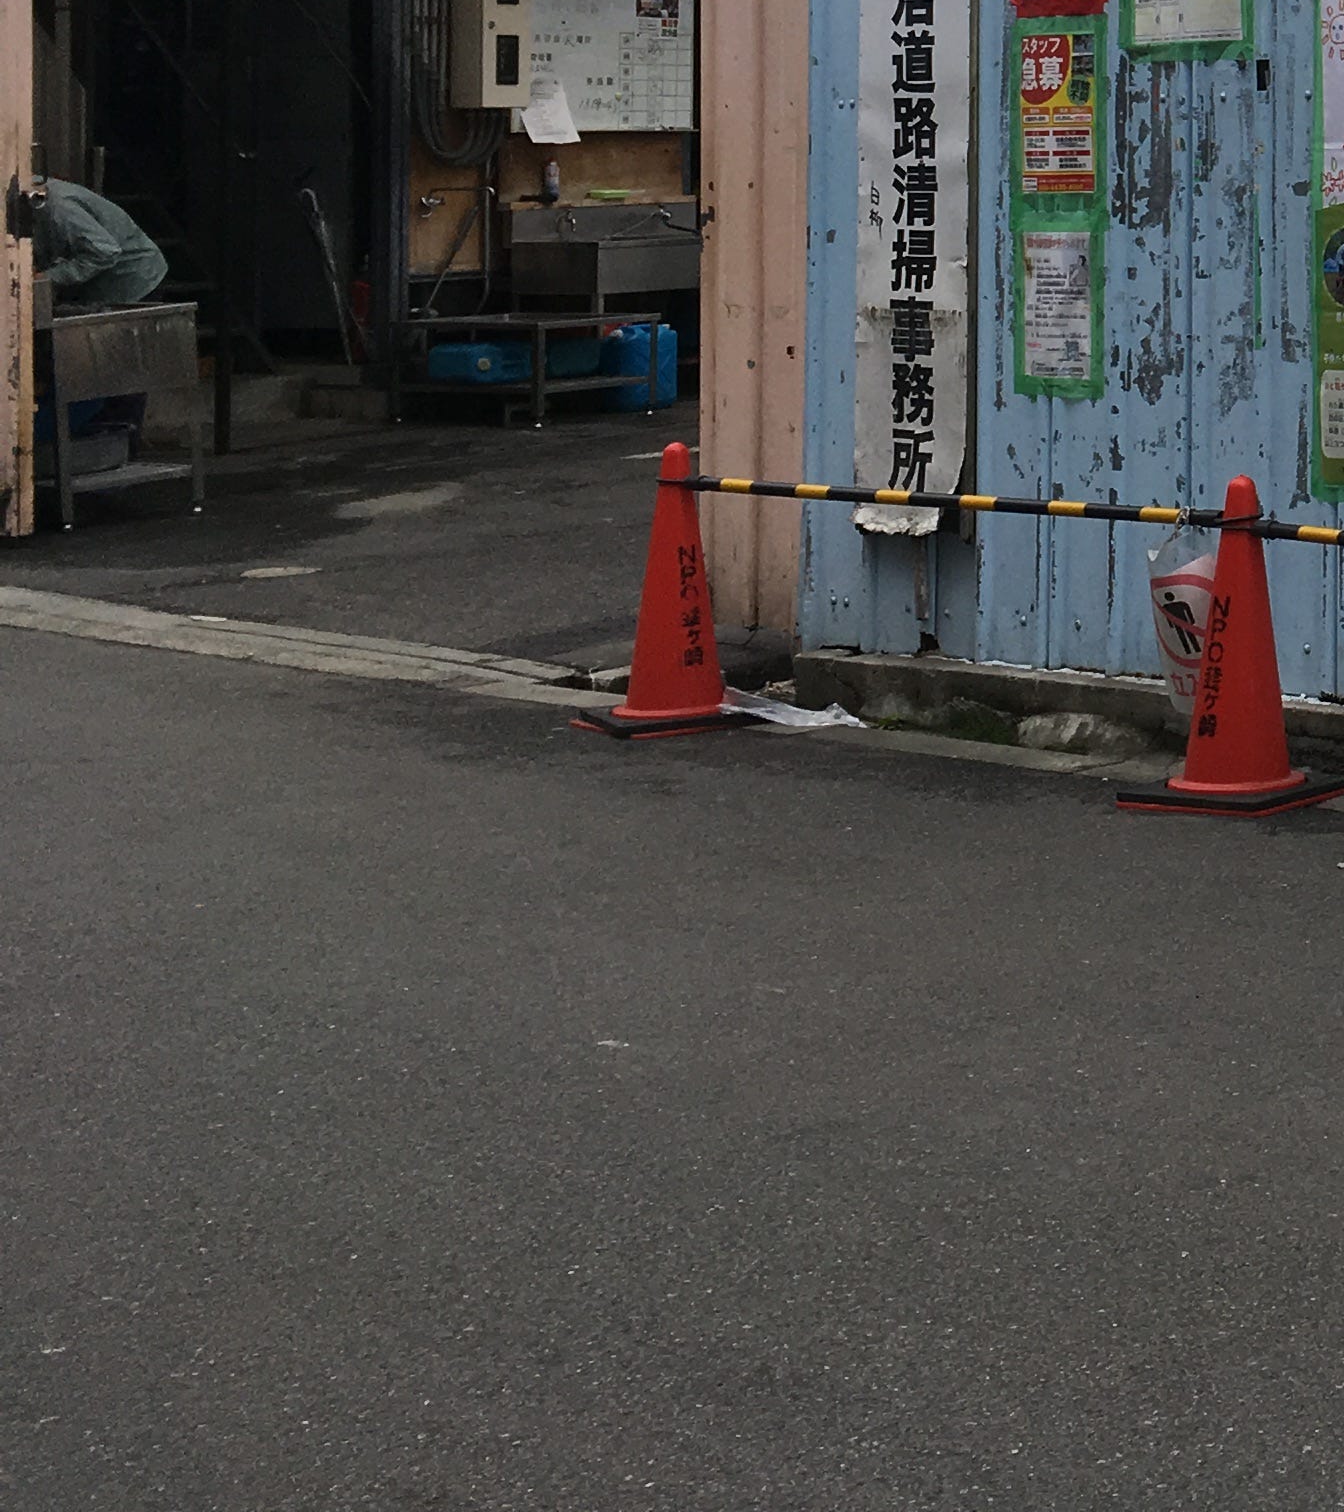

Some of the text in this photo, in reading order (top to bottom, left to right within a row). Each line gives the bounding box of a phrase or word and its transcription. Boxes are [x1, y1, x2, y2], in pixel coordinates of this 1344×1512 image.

[1022, 38, 1061, 54] スタッフ
[1021, 56, 1064, 91] 急募
